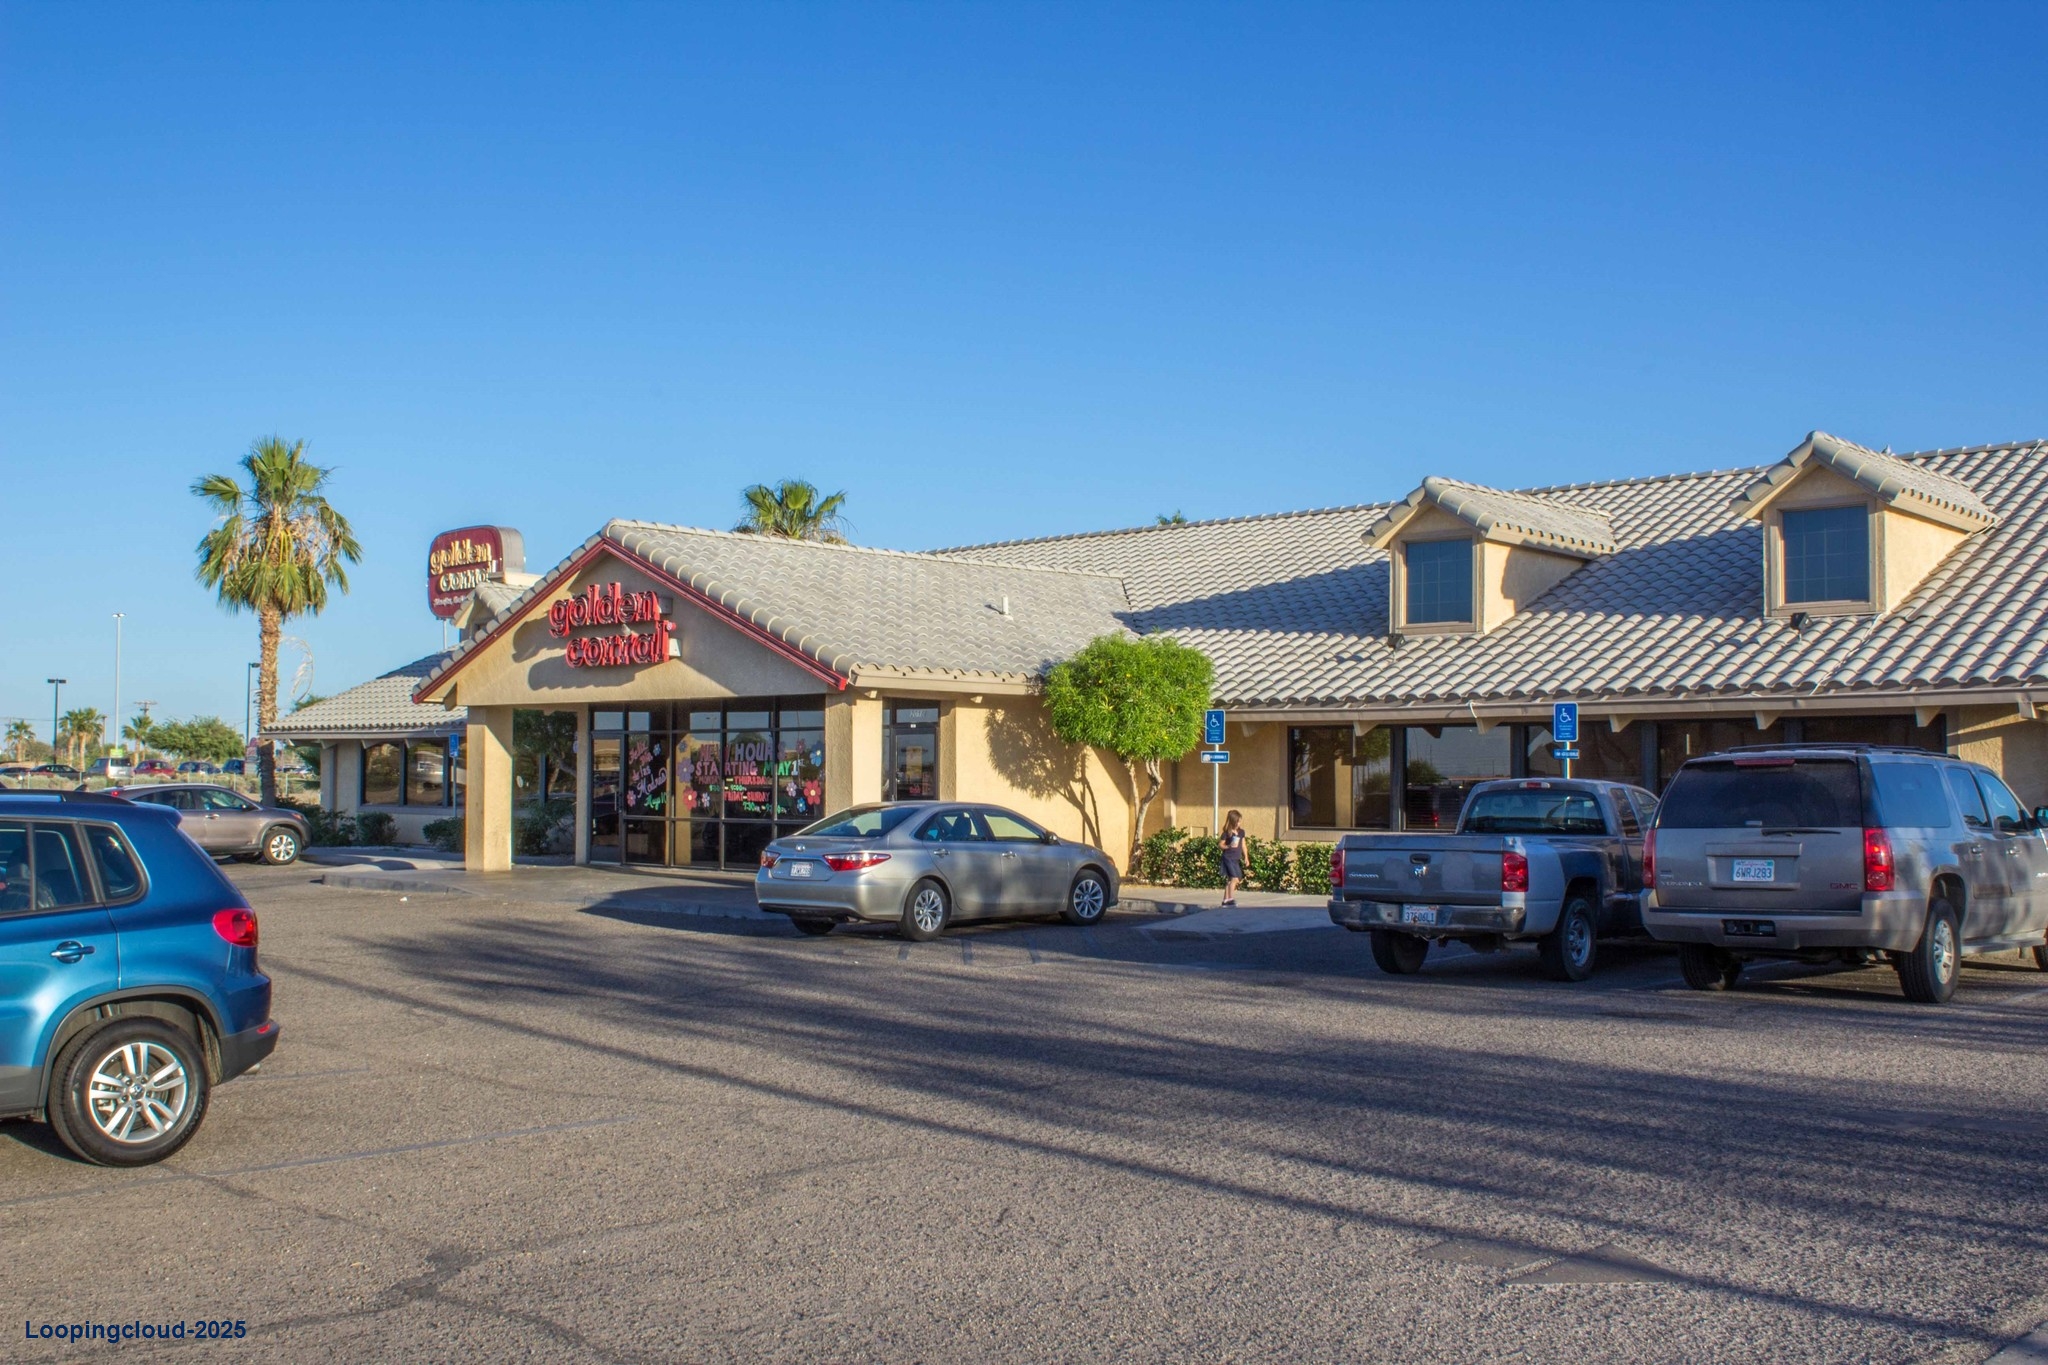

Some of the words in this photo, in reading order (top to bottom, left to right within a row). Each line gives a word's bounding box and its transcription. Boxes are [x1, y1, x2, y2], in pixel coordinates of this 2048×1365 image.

[430, 539, 492, 575] golden
[440, 560, 497, 592] corral
[549, 582, 660, 638] golden
[566, 620, 670, 668] corral
[735, 741, 787, 761] HOURS
[695, 761, 758, 776] STARTING
[763, 760, 792, 776] MAY
[746, 791, 770, 802] SUNDAY
[1735, 867, 1772, 879] 6WRJ283
[1830, 882, 1858, 890] GMC
